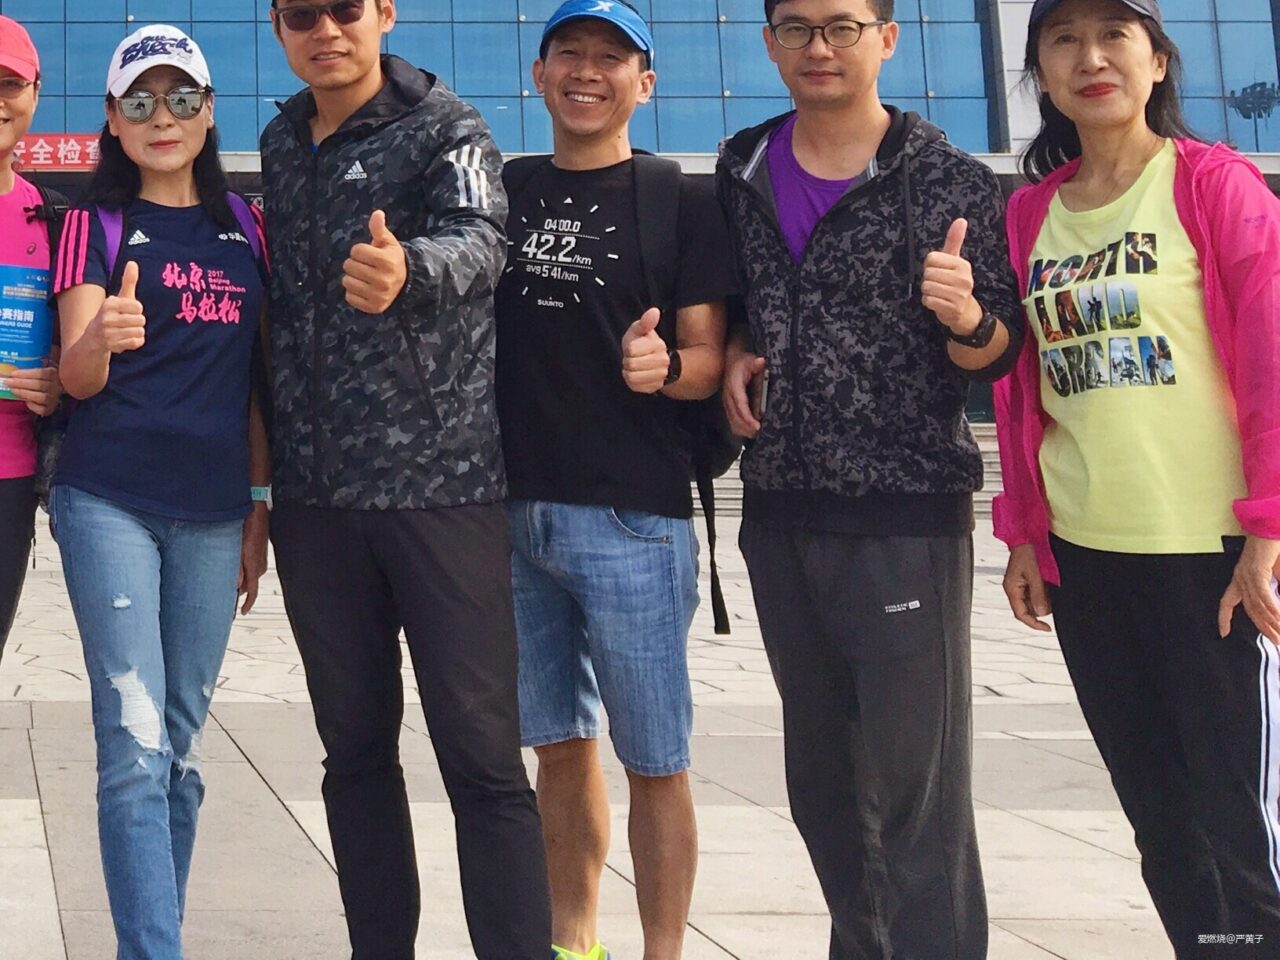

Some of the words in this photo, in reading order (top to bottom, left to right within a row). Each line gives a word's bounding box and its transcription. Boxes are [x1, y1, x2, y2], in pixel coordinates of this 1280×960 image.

[162, 262, 207, 293] 北京
[1028, 231, 1158, 298] NORTH
[210, 283, 246, 293] Marathon
[537, 299, 564, 308] SUUNTO
[175, 291, 242, 324] 马拉松
[1034, 280, 1142, 344] LAND
